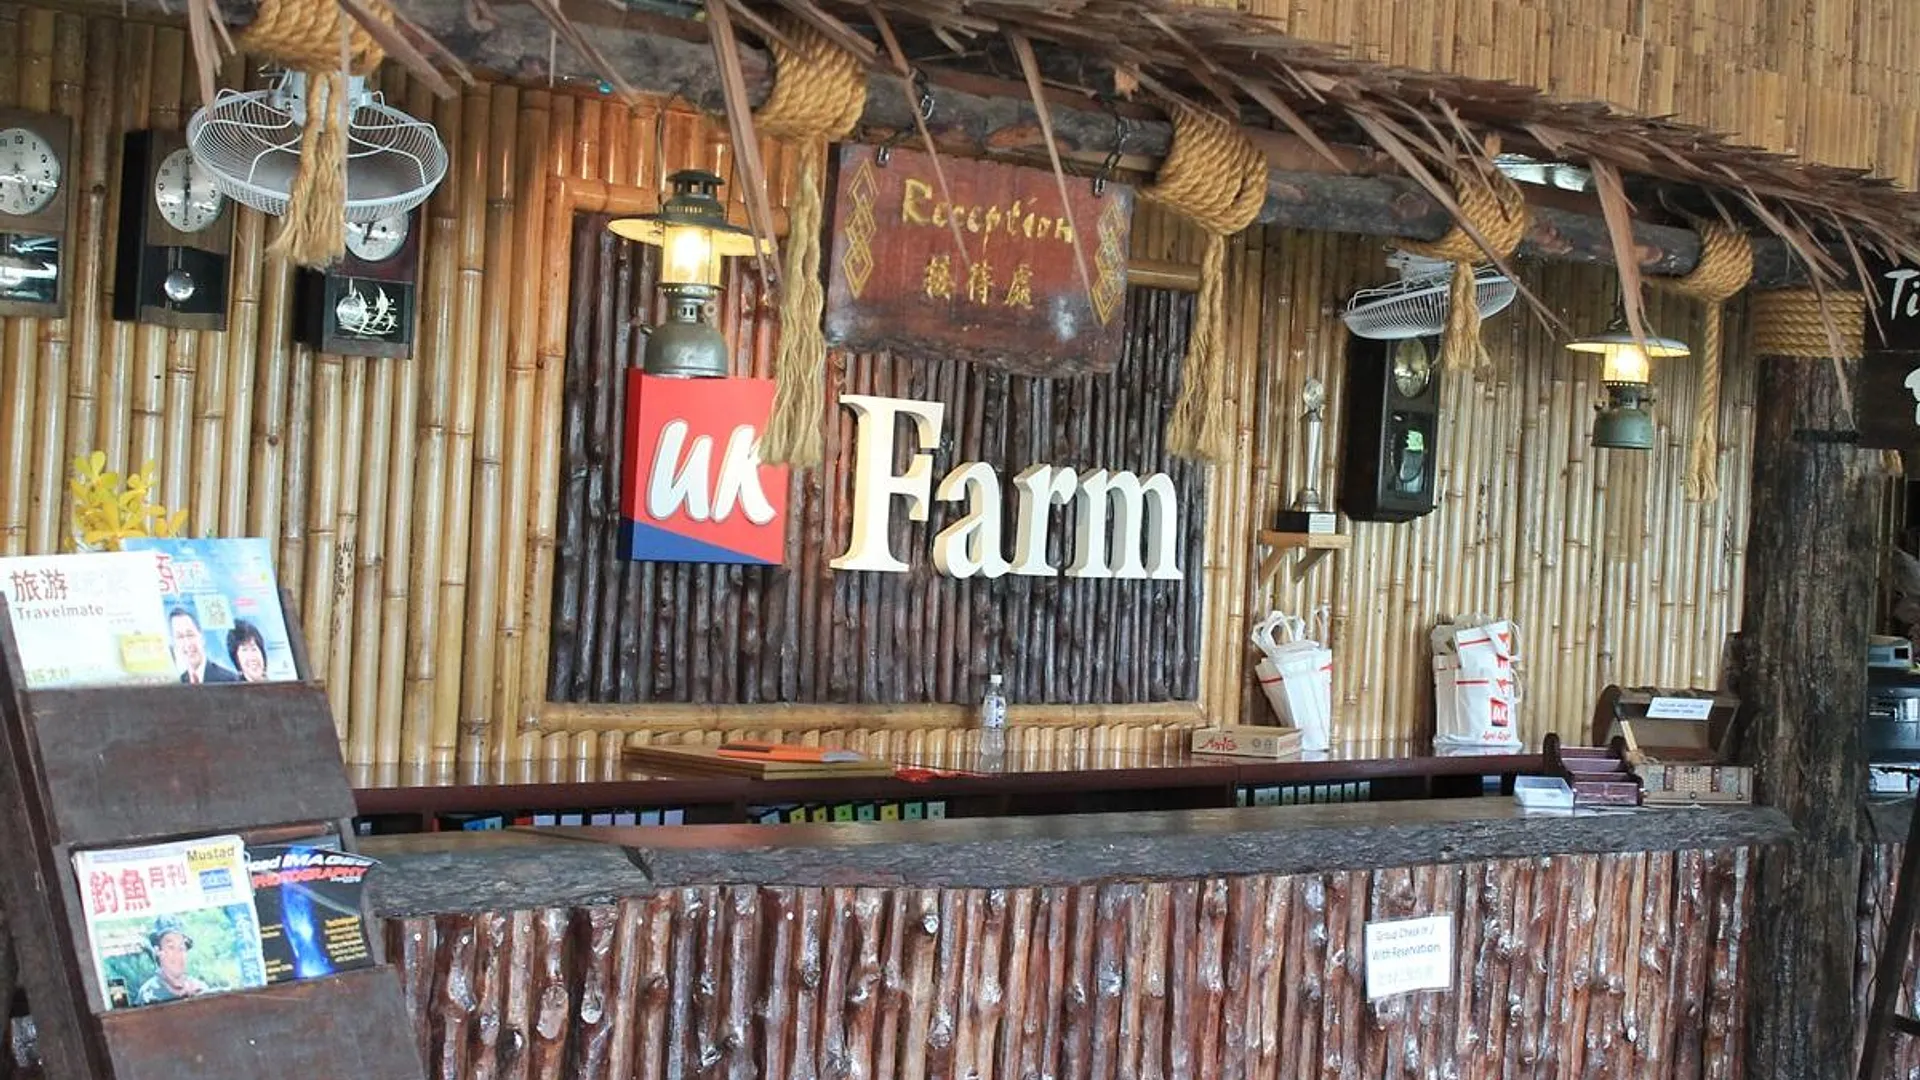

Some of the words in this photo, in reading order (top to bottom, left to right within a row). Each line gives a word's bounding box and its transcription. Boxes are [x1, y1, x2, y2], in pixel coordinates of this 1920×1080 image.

[902, 178, 1074, 256] Reception
[829, 394, 1184, 580] Farm
[16, 604, 104, 620] Travelmate
[186, 845, 235, 862] Mustad
